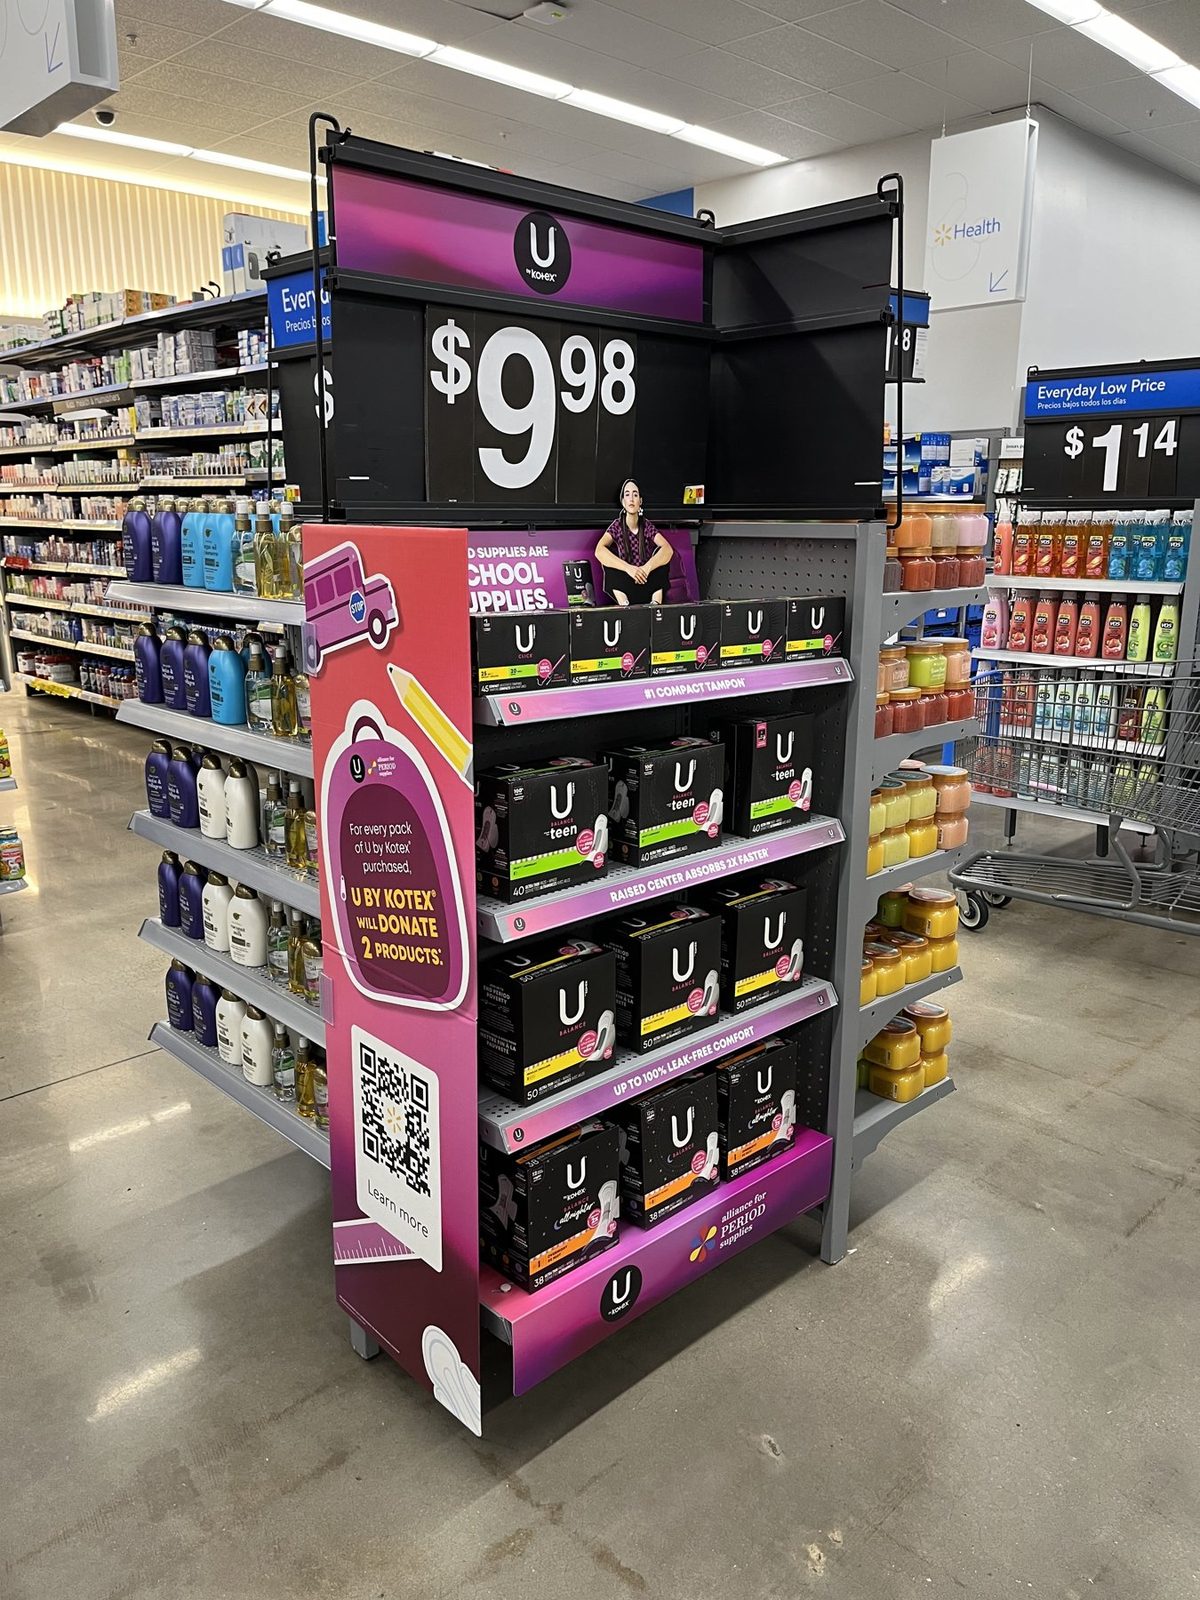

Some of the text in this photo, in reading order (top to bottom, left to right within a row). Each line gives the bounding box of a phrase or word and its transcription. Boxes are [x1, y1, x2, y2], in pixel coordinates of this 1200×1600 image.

[954, 218, 1001, 240] Health
[530, 222, 555, 268] U
[286, 317, 311, 334] Precios
[1038, 379, 1166, 401] Everyday Low Price
[1037, 402, 1061, 410] Precios
[1062, 401, 1079, 409] bajos
[1081, 399, 1101, 407] todos
[1101, 398, 1111, 406] los
[477, 546, 527, 559] SUPPLIES
[529, 546, 549, 557] ARE
[351, 600, 364, 613] STOP
[680, 614, 695, 641] U
[748, 610, 762, 635] U
[811, 606, 823, 630] U
[515, 624, 533, 653] U
[603, 620, 620, 647] U
[644, 688, 656, 699] #1
[657, 682, 706, 697] COMPACT
[776, 730, 793, 764] U
[352, 758, 361, 774] U
[674, 759, 694, 792] U
[775, 768, 795, 781] teen
[550, 781, 573, 819] U
[671, 797, 695, 811] teen
[349, 821, 413, 837] For every pack
[550, 825, 578, 840] teen
[551, 818, 574, 828] BALANCE
[752, 824, 761, 833] 40
[354, 841, 364, 853] of
[364, 841, 372, 851] U
[373, 841, 384, 857] by
[641, 852, 650, 862] 40
[363, 860, 412, 875] purchased,
[513, 885, 525, 897] 40
[609, 884, 646, 903] RAISED
[648, 874, 684, 893] CENTER
[685, 863, 725, 883] ABSORBS
[726, 858, 739, 871] 2X
[350, 887, 361, 907] U
[363, 887, 380, 908] BY
[356, 914, 439, 938] WILL DONATE
[764, 911, 784, 949] U
[361, 935, 373, 959] 2
[672, 941, 695, 983] U
[671, 978, 696, 993] BALANCE
[559, 980, 585, 1026] U
[736, 1000, 745, 1010] 50
[559, 1021, 587, 1037] BALANCE
[642, 1038, 653, 1050] 50
[613, 1081, 628, 1096] UP
[628, 1076, 642, 1090] TO
[642, 1064, 667, 1084] 100%
[668, 1042, 714, 1071] LEAK-FREE
[714, 1026, 756, 1050] COMFORT
[757, 1065, 773, 1094] U
[527, 1088, 539, 1101] 50
[671, 1106, 693, 1148] U
[672, 1143, 695, 1158] BALANCE
[567, 1156, 586, 1189] U
[730, 1168, 739, 1178] 38
[367, 1179, 429, 1238] Learn more
[648, 1211, 658, 1223] 38
[721, 1191, 767, 1224] alliance for
[720, 1203, 766, 1239] PERIOD
[720, 1224, 753, 1250] supplies
[533, 1275, 545, 1289] 38
[612, 1270, 631, 1304] U
